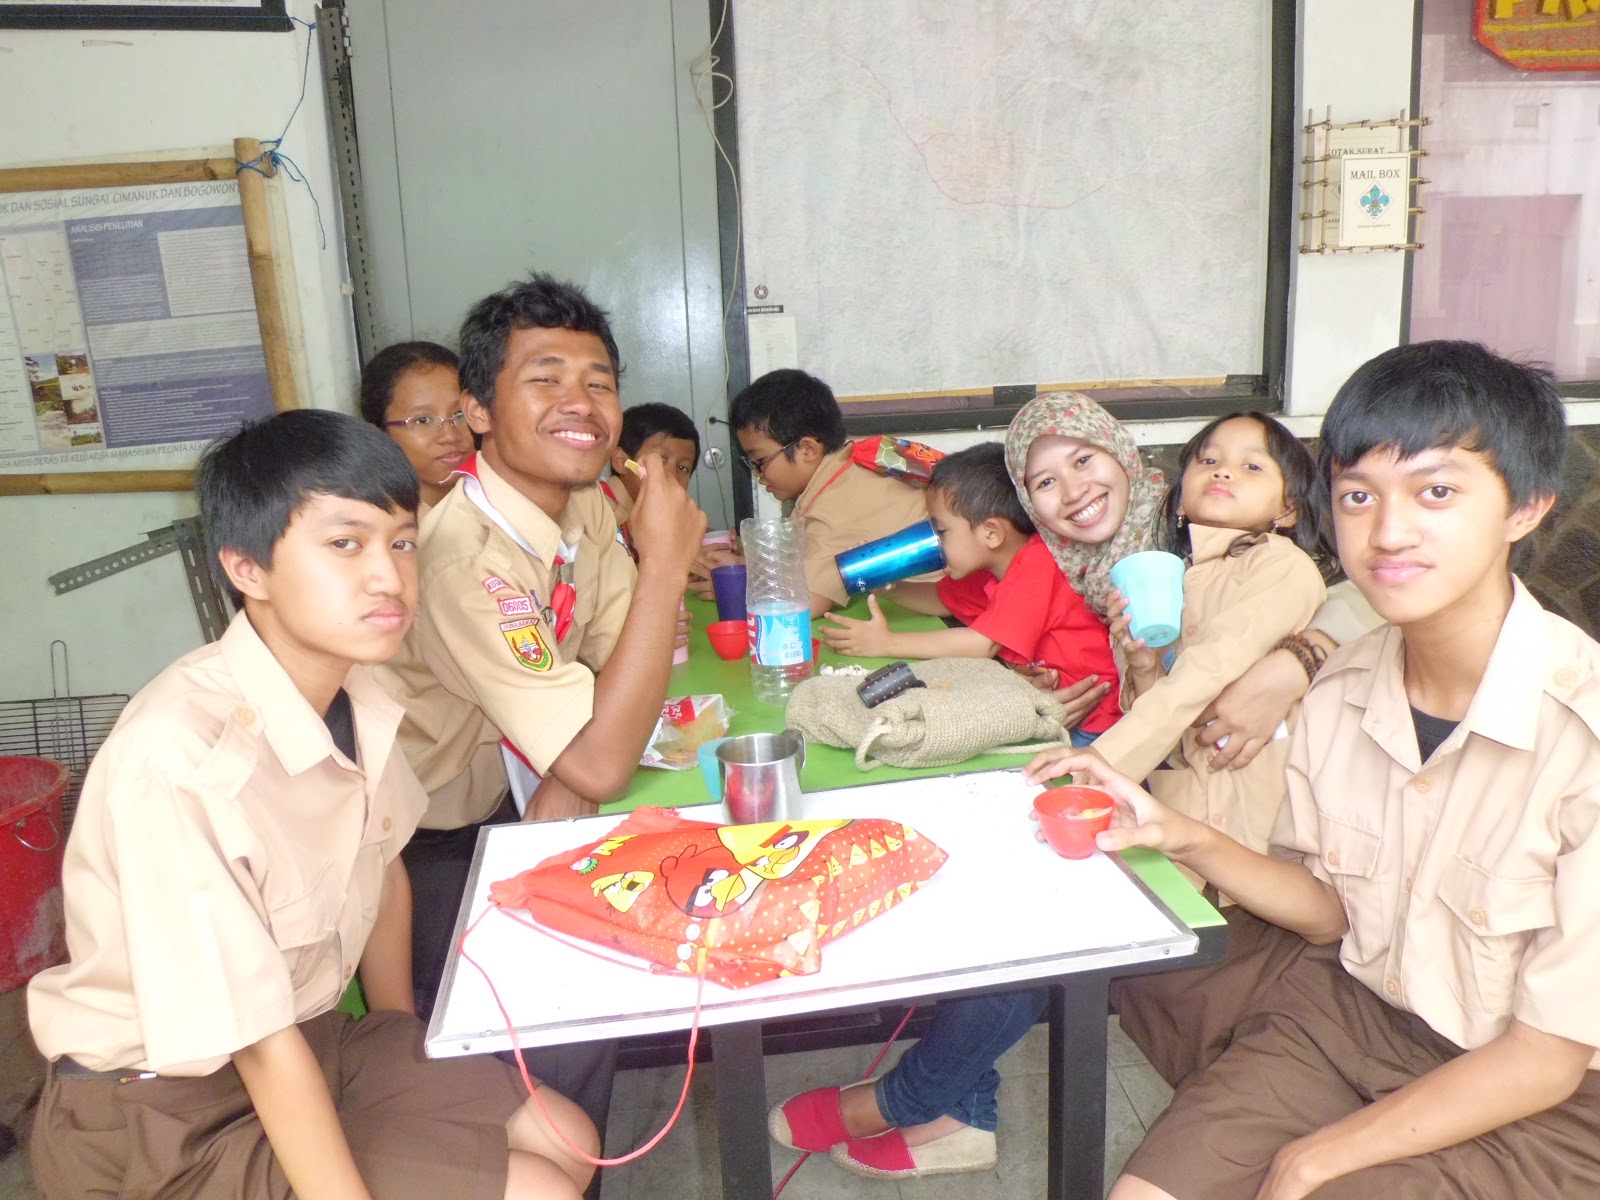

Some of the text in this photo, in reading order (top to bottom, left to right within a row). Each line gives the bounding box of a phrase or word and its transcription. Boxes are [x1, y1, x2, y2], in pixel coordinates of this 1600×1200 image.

[1357, 146, 1385, 155] SURAT
[1350, 169, 1400, 180] MAIL BOX
[11, 201, 32, 213] DAN
[34, 197, 69, 212] SOSIAL
[71, 193, 110, 208] SUNGAI
[113, 188, 159, 204] CIMANUK
[160, 186, 182, 199] DAN
[71, 219, 144, 234] ANALISIS PENELITIAN
[111, 446, 156, 459] MAHASISWA
[157, 444, 188, 455] PECINTA
[502, 600, 528, 612] 06005
